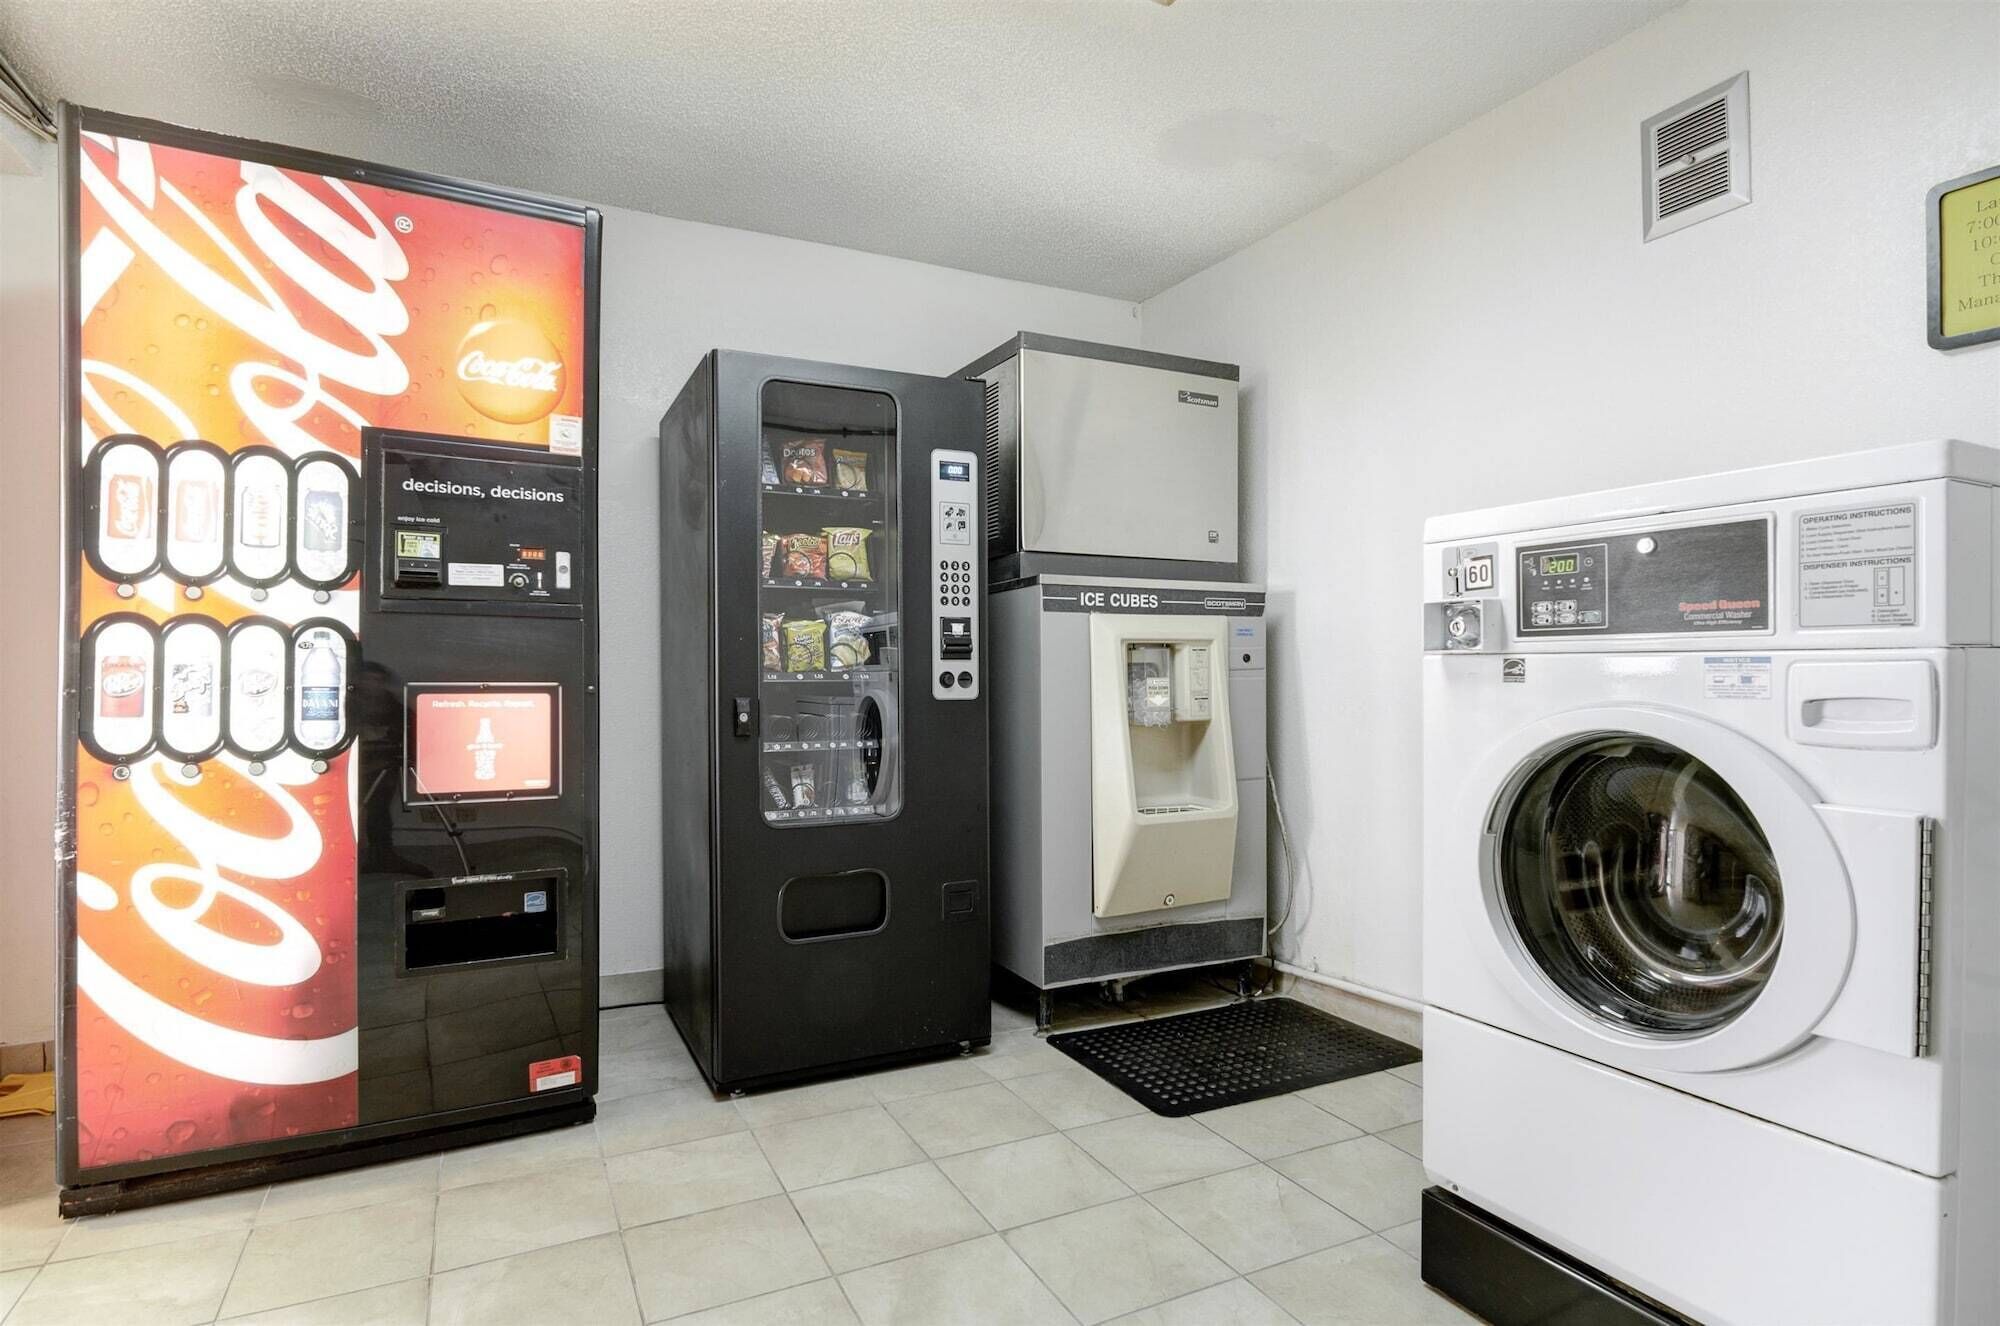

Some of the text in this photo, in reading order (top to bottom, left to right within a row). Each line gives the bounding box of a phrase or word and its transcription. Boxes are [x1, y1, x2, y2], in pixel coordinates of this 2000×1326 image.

[1977, 198, 2000, 212] La
[1973, 235, 2000, 252] 10:
[457, 350, 562, 392] Coca-Cola
[1186, 395, 1218, 407] Scotsman
[783, 448, 816, 457] Doritos
[402, 478, 564, 503] decisions, decisions
[397, 515, 415, 523] enjoy
[1802, 506, 1912, 525] OPERATING INSTRUCTIONS
[1802, 556, 1912, 571] DISPENSER INSTRUCTIONS
[1469, 564, 1488, 584] 60
[1080, 591, 1159, 609] ICE CUBES
[1679, 599, 1761, 612] Speed Queen
[1683, 610, 1753, 621] Commercial Washer
